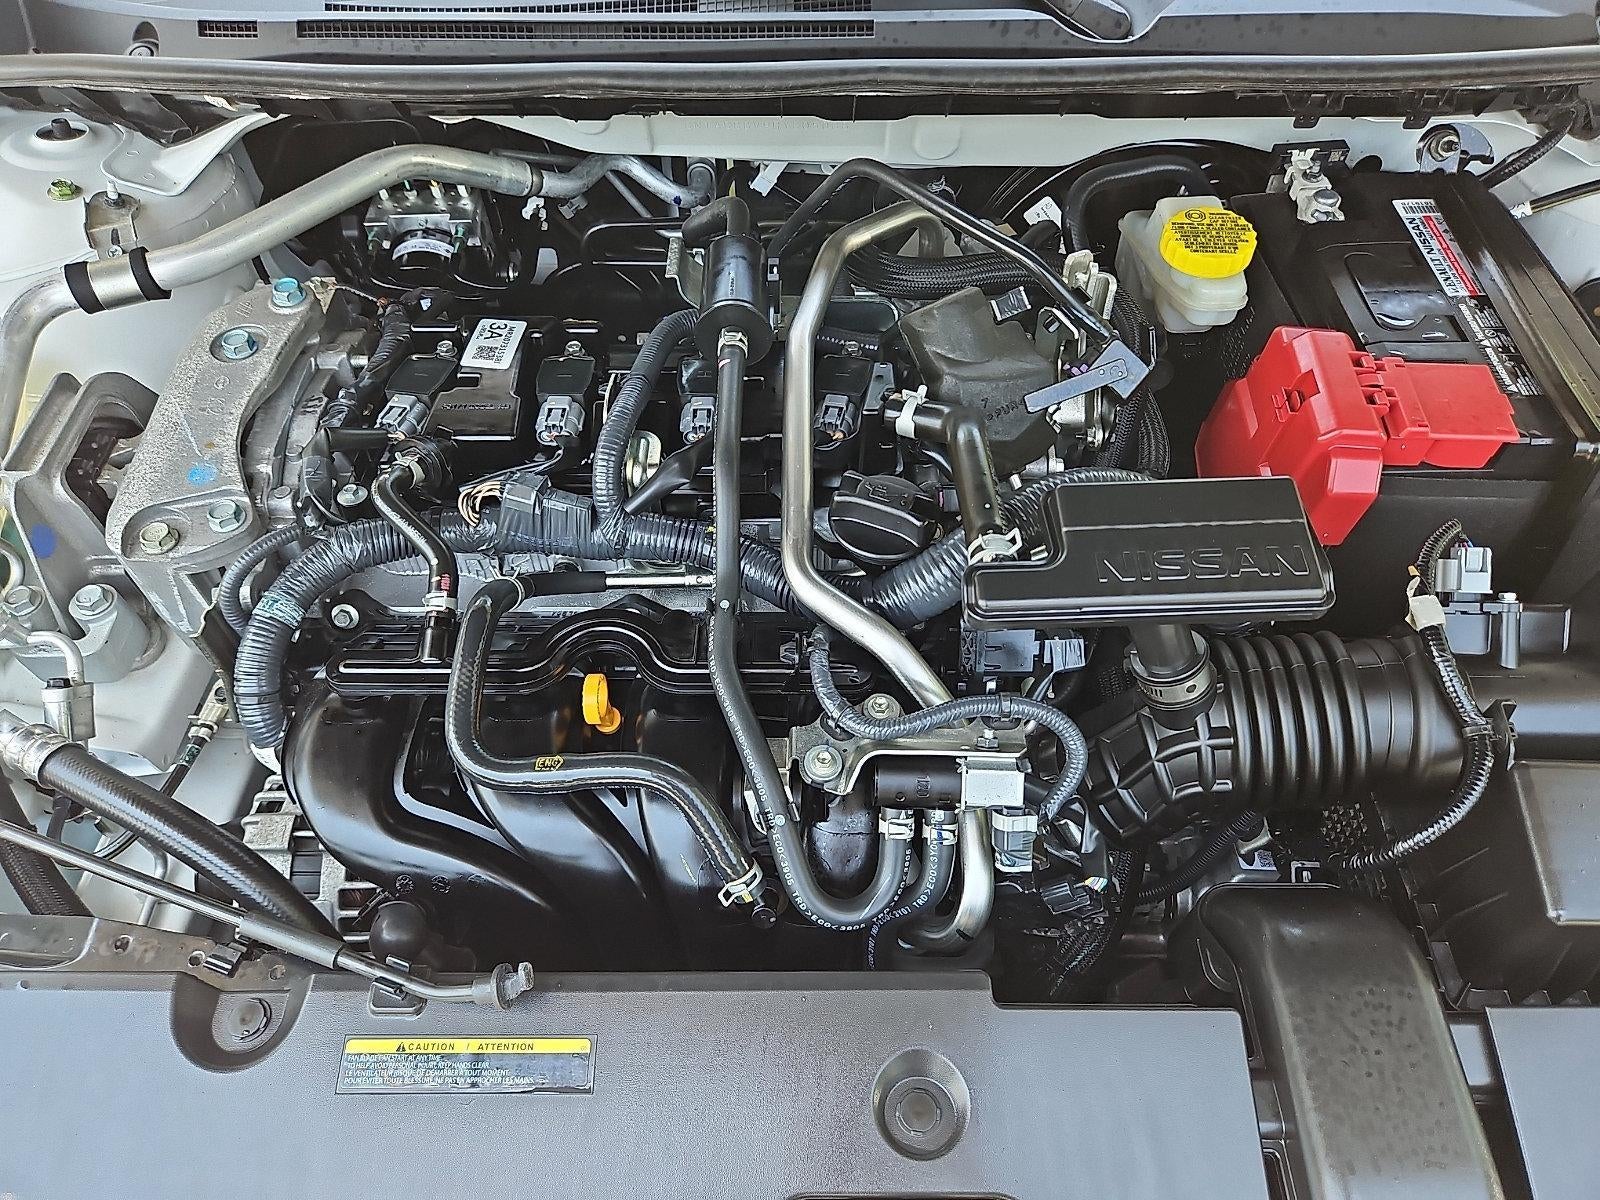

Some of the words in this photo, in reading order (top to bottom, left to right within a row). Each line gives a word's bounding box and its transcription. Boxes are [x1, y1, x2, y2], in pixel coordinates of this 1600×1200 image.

[1405, 217, 1436, 255] NISSAN
[484, 321, 508, 341] 3A
[1097, 545, 1310, 583] NISSAN
[538, 758, 558, 768] ENG
[408, 1042, 455, 1051] CAUTION
[477, 1042, 534, 1051] ATTENTION
